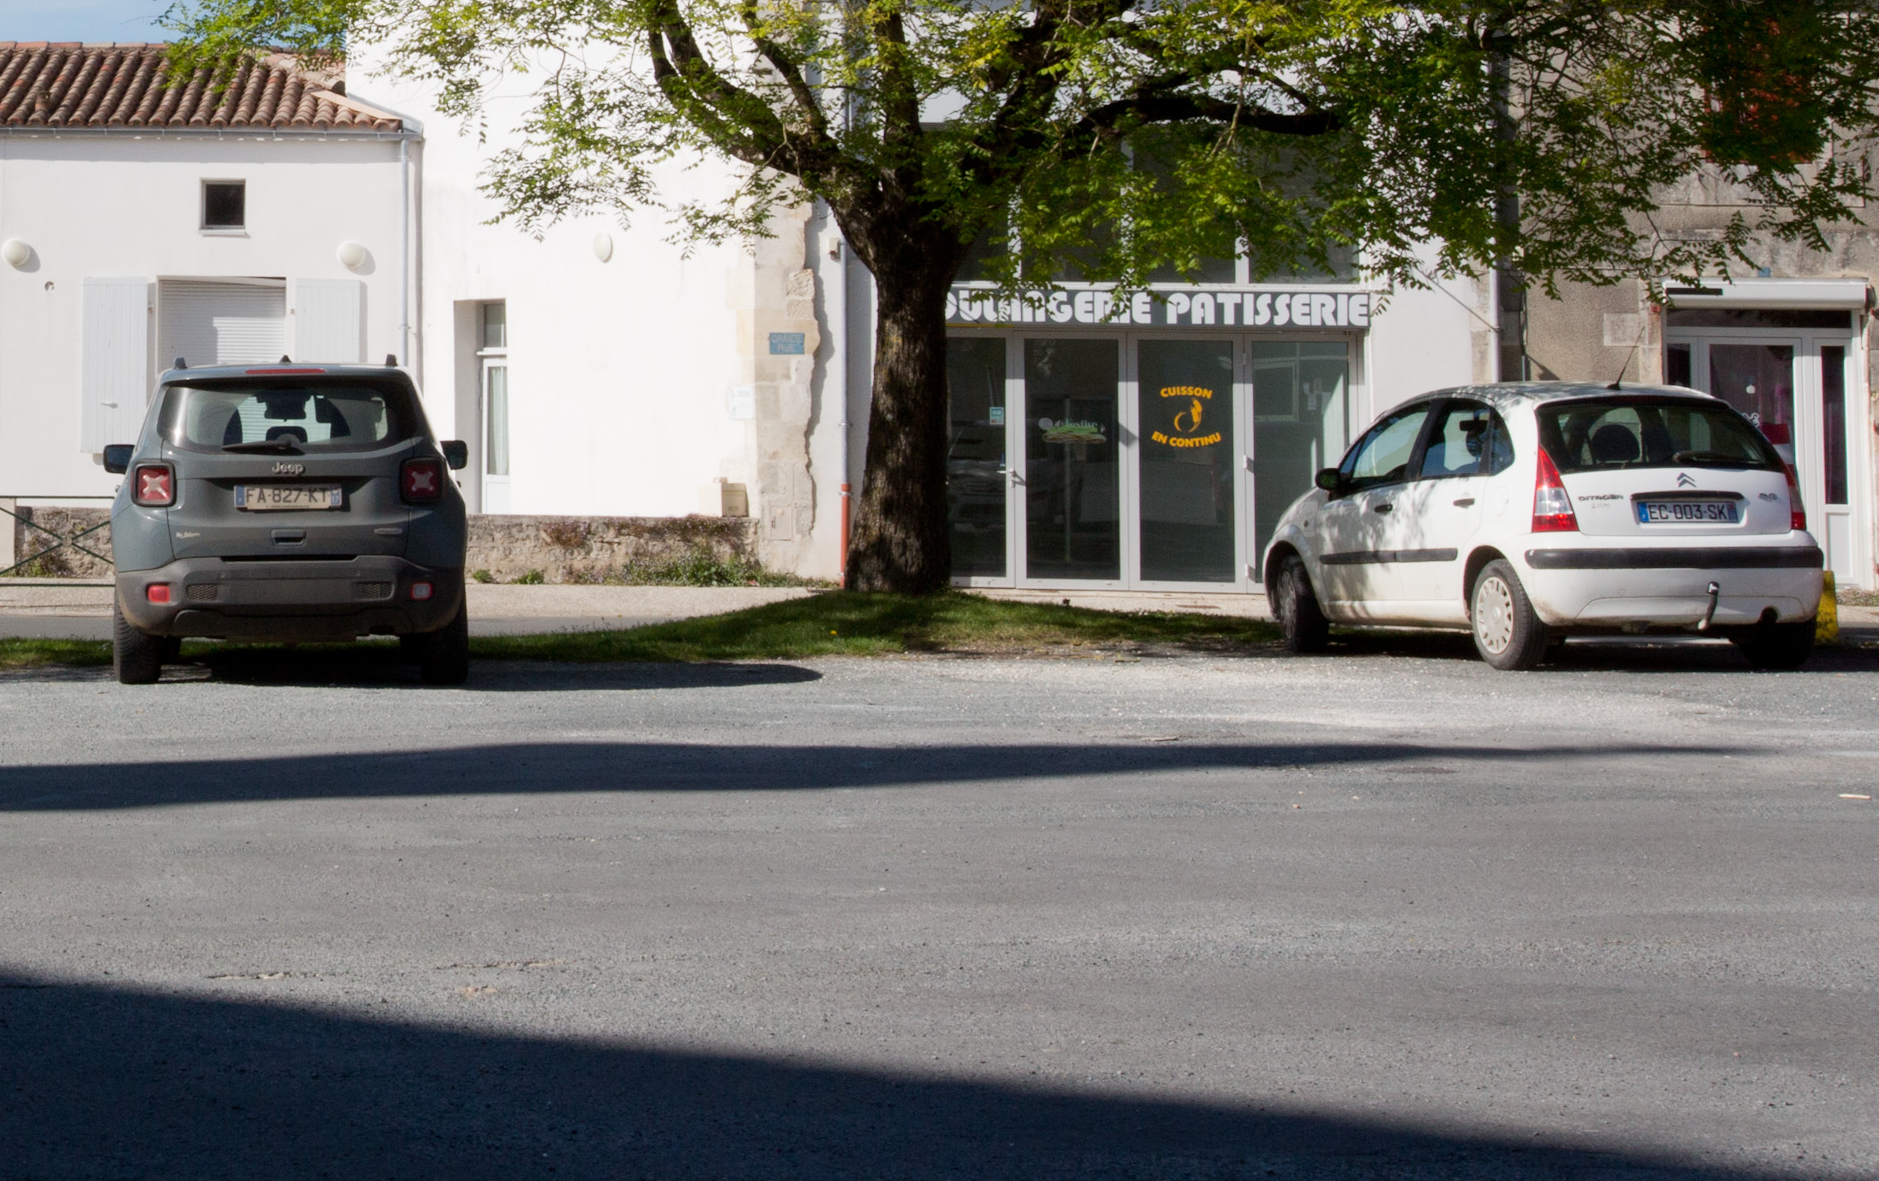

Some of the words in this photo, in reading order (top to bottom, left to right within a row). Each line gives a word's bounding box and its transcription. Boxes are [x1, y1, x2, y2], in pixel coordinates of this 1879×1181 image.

[945, 290, 1152, 324] ULANGERIE
[1166, 292, 1369, 327] PATISSERIE
[1160, 385, 1213, 400] CUISSON
[1151, 431, 1168, 444] EN
[1169, 431, 1222, 448] CONTINU
[272, 462, 303, 474] Jeep
[246, 489, 329, 503] FA-827-KT
[1647, 504, 1728, 520] EC-003-SK
